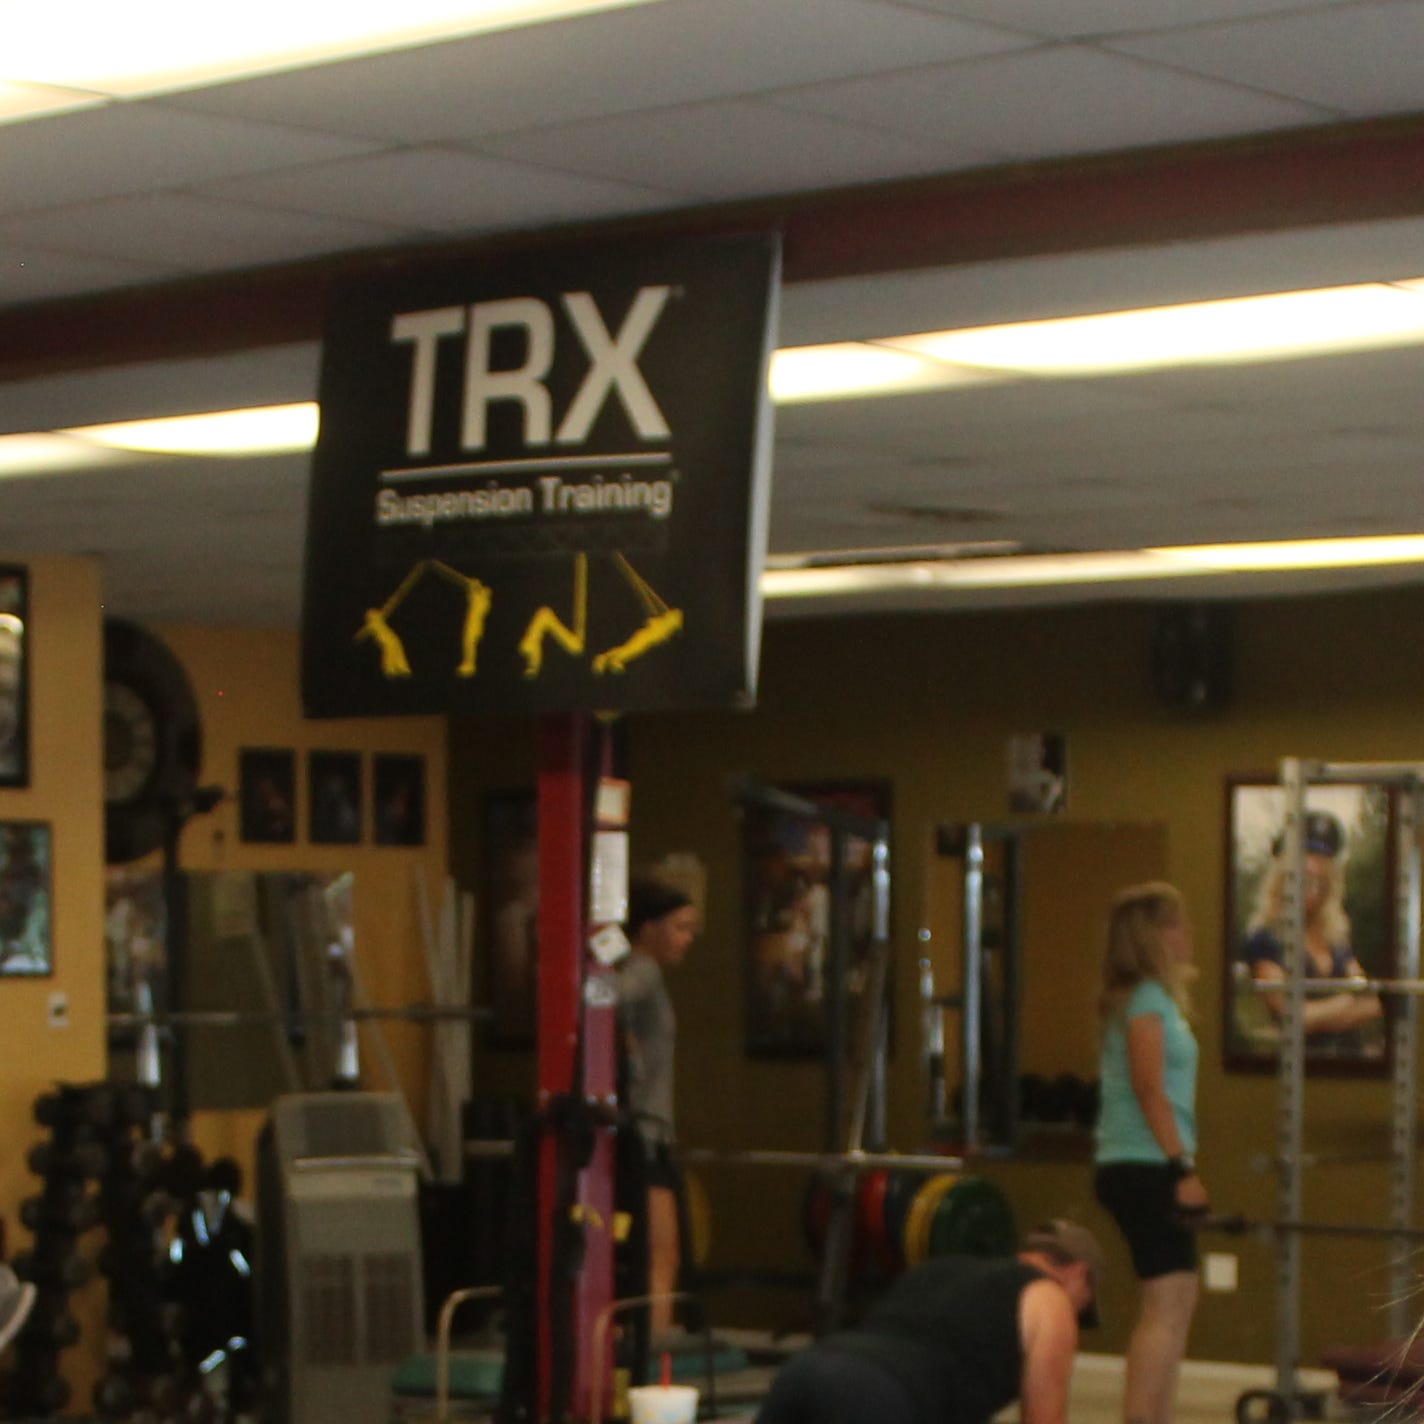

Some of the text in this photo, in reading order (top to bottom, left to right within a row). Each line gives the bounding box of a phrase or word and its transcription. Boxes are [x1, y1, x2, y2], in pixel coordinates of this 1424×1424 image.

[391, 285, 672, 456] TRX
[377, 474, 673, 527] Suspension Training
